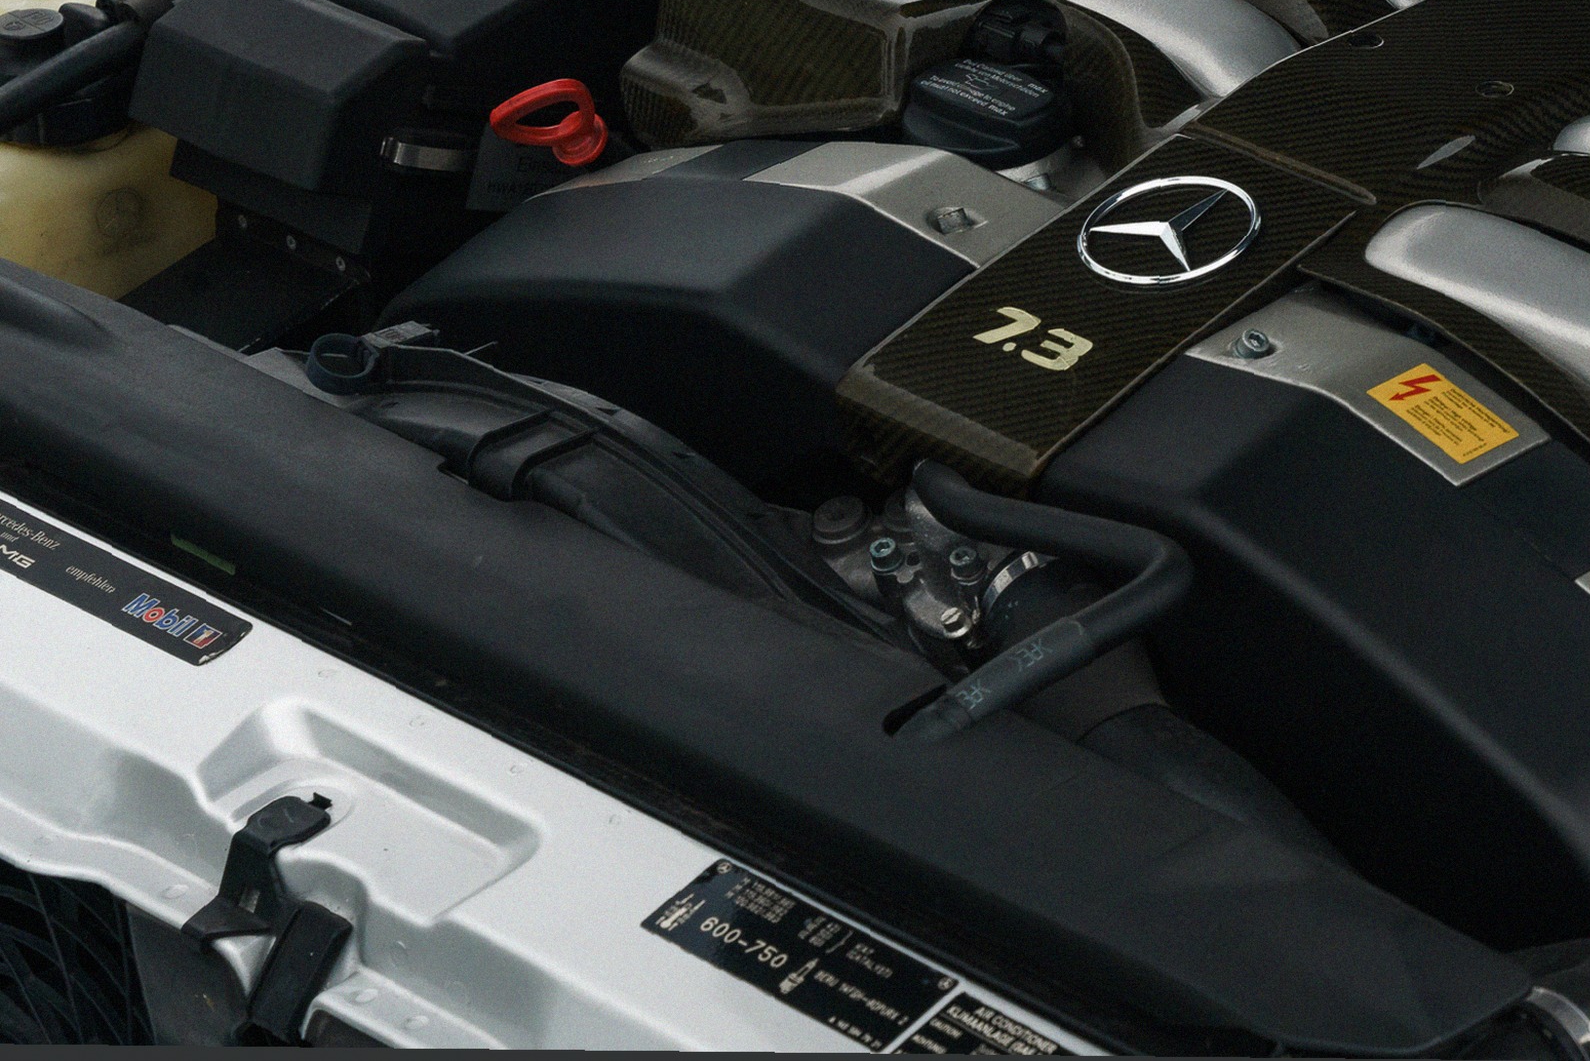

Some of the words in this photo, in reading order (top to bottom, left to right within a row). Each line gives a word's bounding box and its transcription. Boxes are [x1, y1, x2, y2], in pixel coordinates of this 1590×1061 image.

[973, 306, 1093, 371] 7.3
[0, 513, 60, 550] rcedes-Benz
[65, 565, 116, 594] empfehlen
[122, 593, 199, 637] Mobil
[700, 916, 788, 968] 600-750
[991, 1015, 1060, 1055] CONDITIONER
